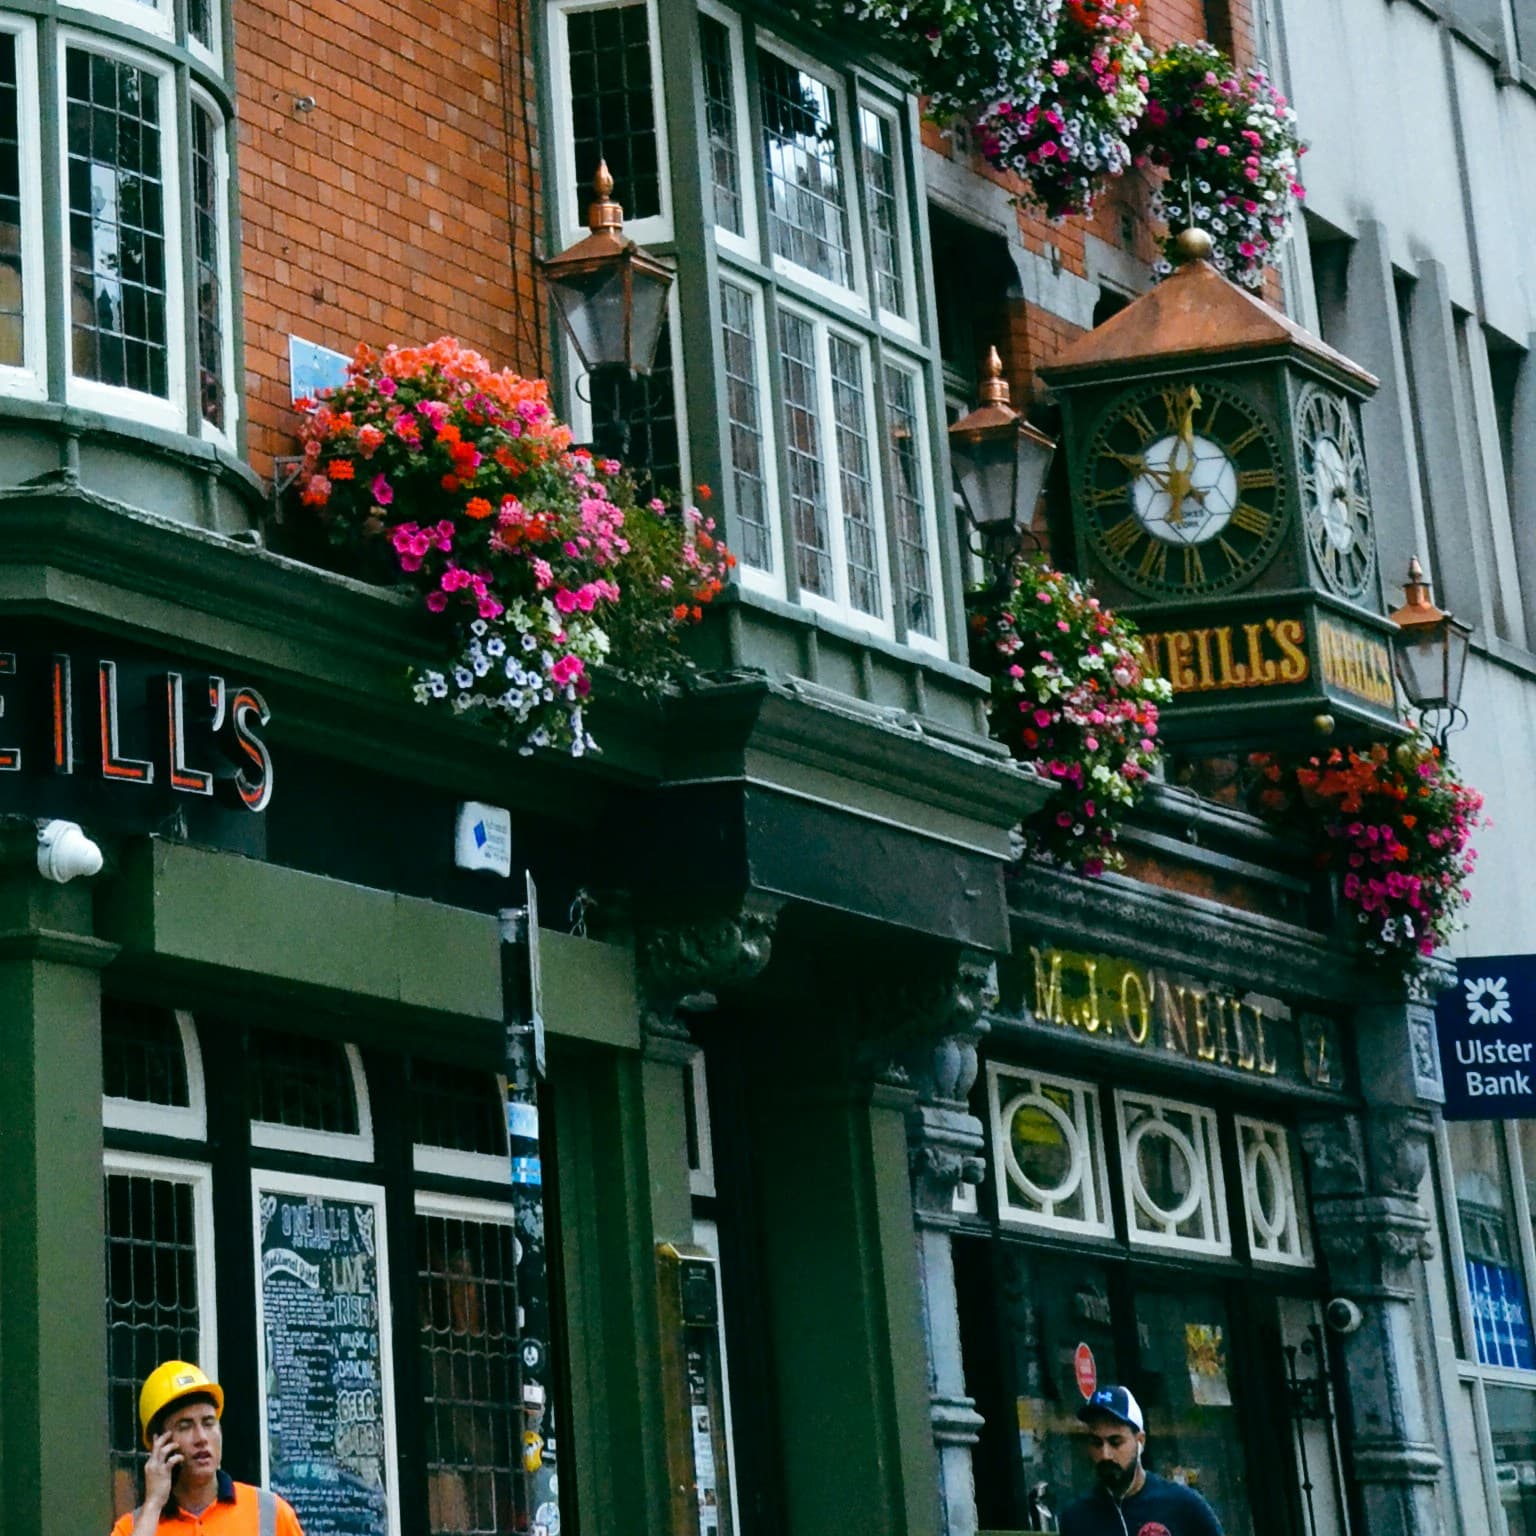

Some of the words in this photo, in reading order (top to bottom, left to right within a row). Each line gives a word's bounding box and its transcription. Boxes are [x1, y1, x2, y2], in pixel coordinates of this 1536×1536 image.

[1455, 1038, 1533, 1064] Ulster
[1466, 1069, 1532, 1096] Bank
[340, 1332, 369, 1349] MUSIC
